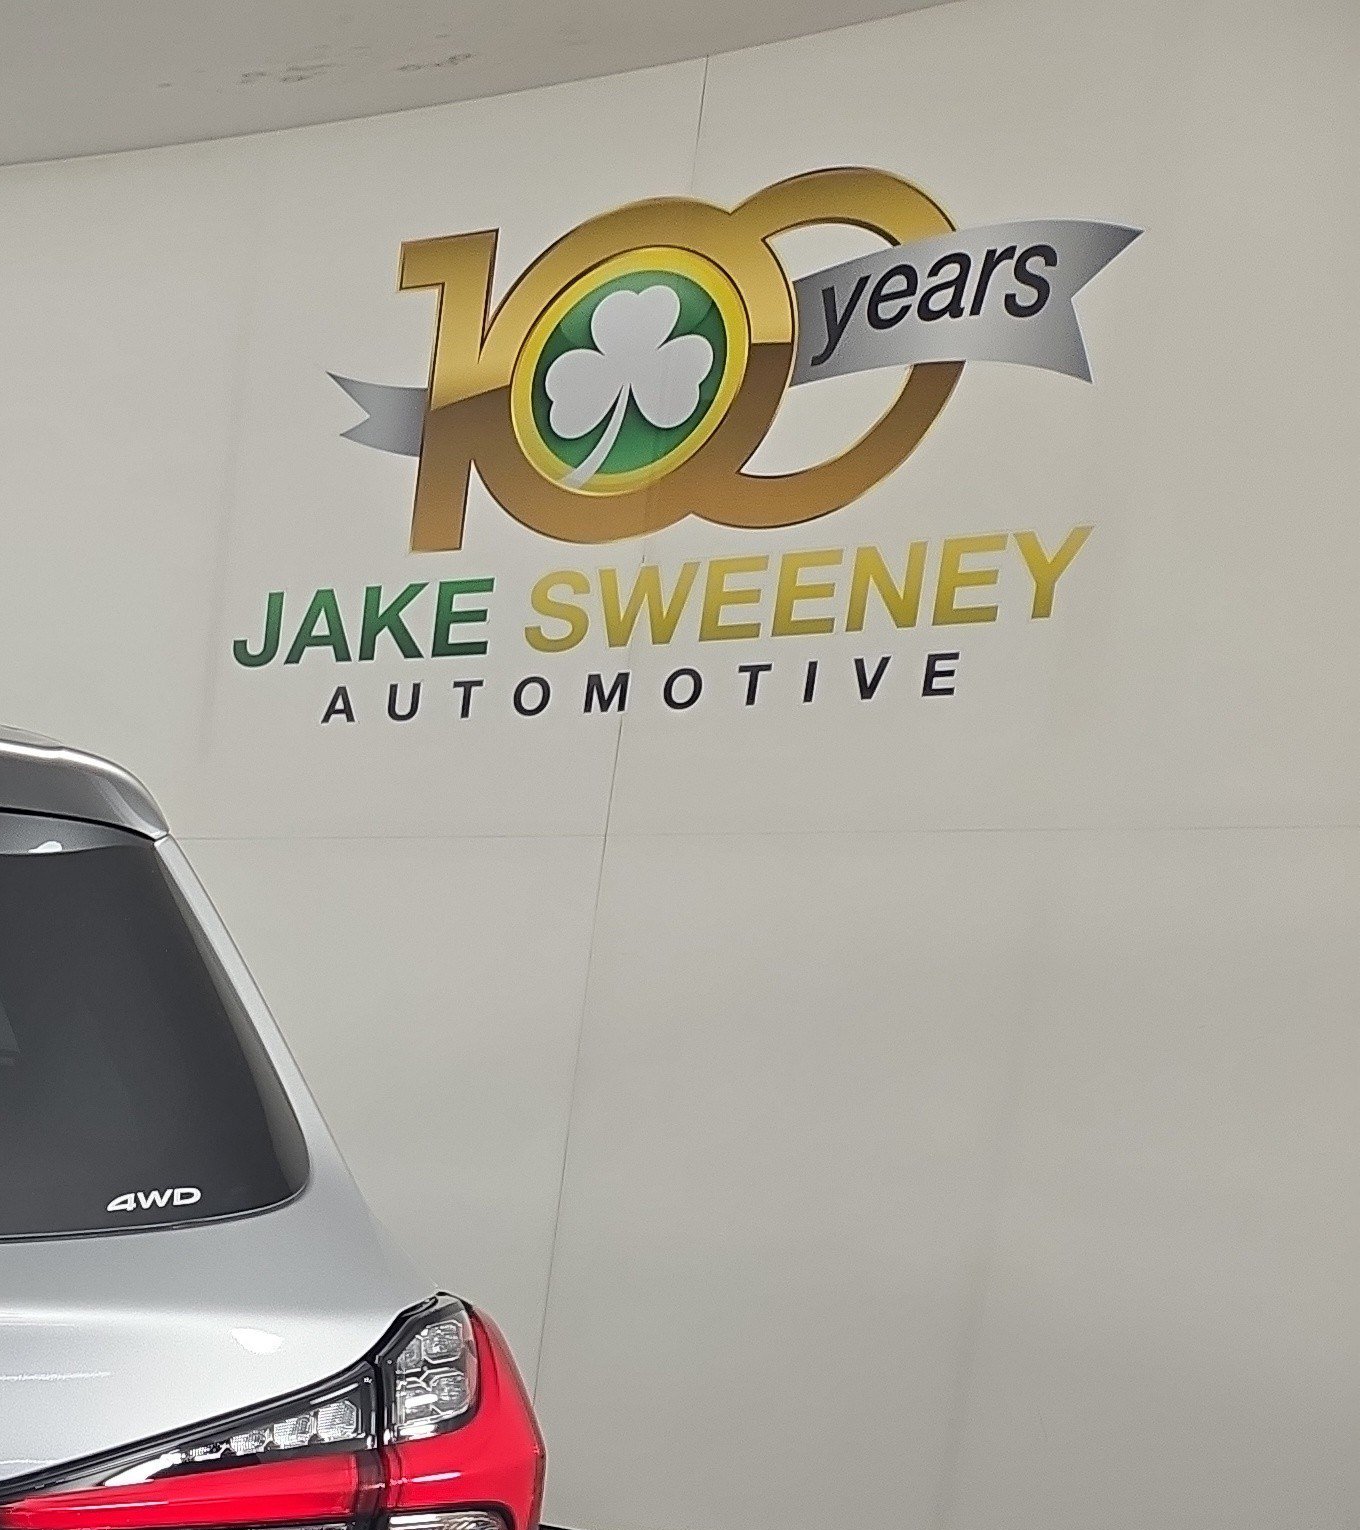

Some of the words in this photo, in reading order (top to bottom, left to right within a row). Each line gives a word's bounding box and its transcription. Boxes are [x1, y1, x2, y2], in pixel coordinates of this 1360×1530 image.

[396, 166, 964, 554] 100
[810, 242, 1060, 367] years
[232, 577, 496, 668] JAKE
[523, 525, 1094, 654] SWEENEY
[321, 652, 961, 724] AUTOMOTIVE
[106, 1187, 202, 1212] 4WD
